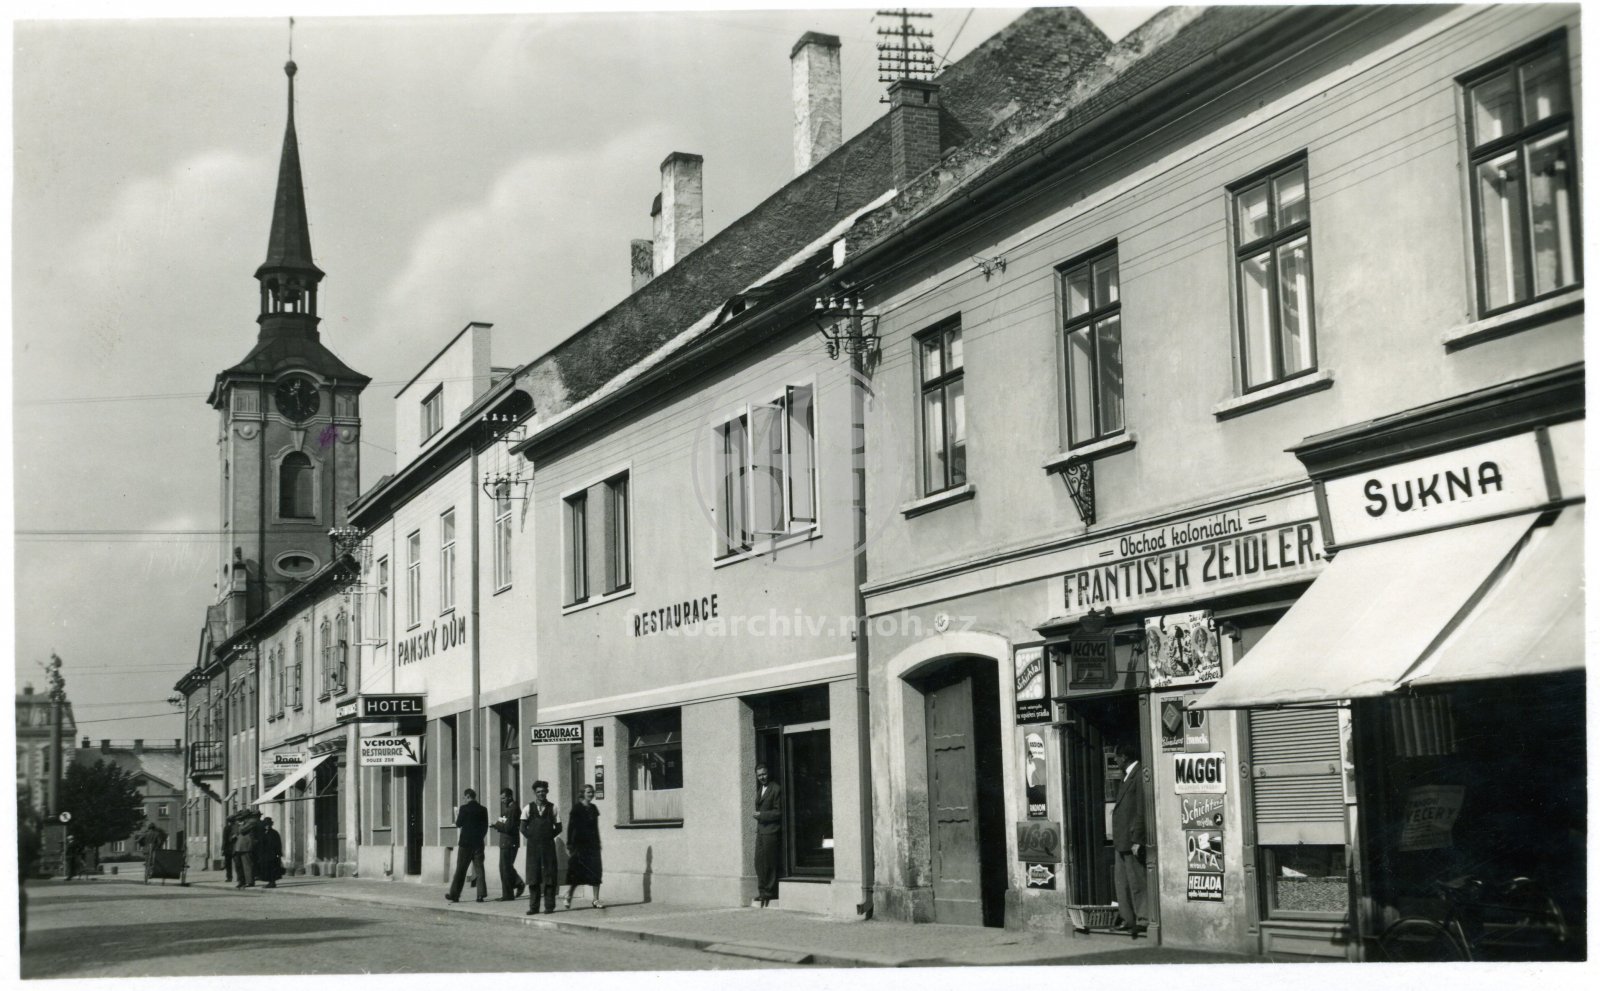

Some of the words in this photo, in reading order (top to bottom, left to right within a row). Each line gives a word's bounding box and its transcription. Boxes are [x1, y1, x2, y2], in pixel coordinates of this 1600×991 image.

[1363, 461, 1503, 517] SUKNA
[1120, 528, 1166, 557] Obchod
[634, 593, 719, 638] RESTAURACE
[398, 620, 438, 667] PANSKÝ
[367, 700, 422, 712] HOTEL
[534, 727, 580, 739] RESTAURACE
[362, 747, 403, 756] RESTAURACE
[1175, 758, 1222, 784] MAGGI
[1029, 804, 1046, 812] RADION
[1188, 876, 1223, 890] HELLADA
